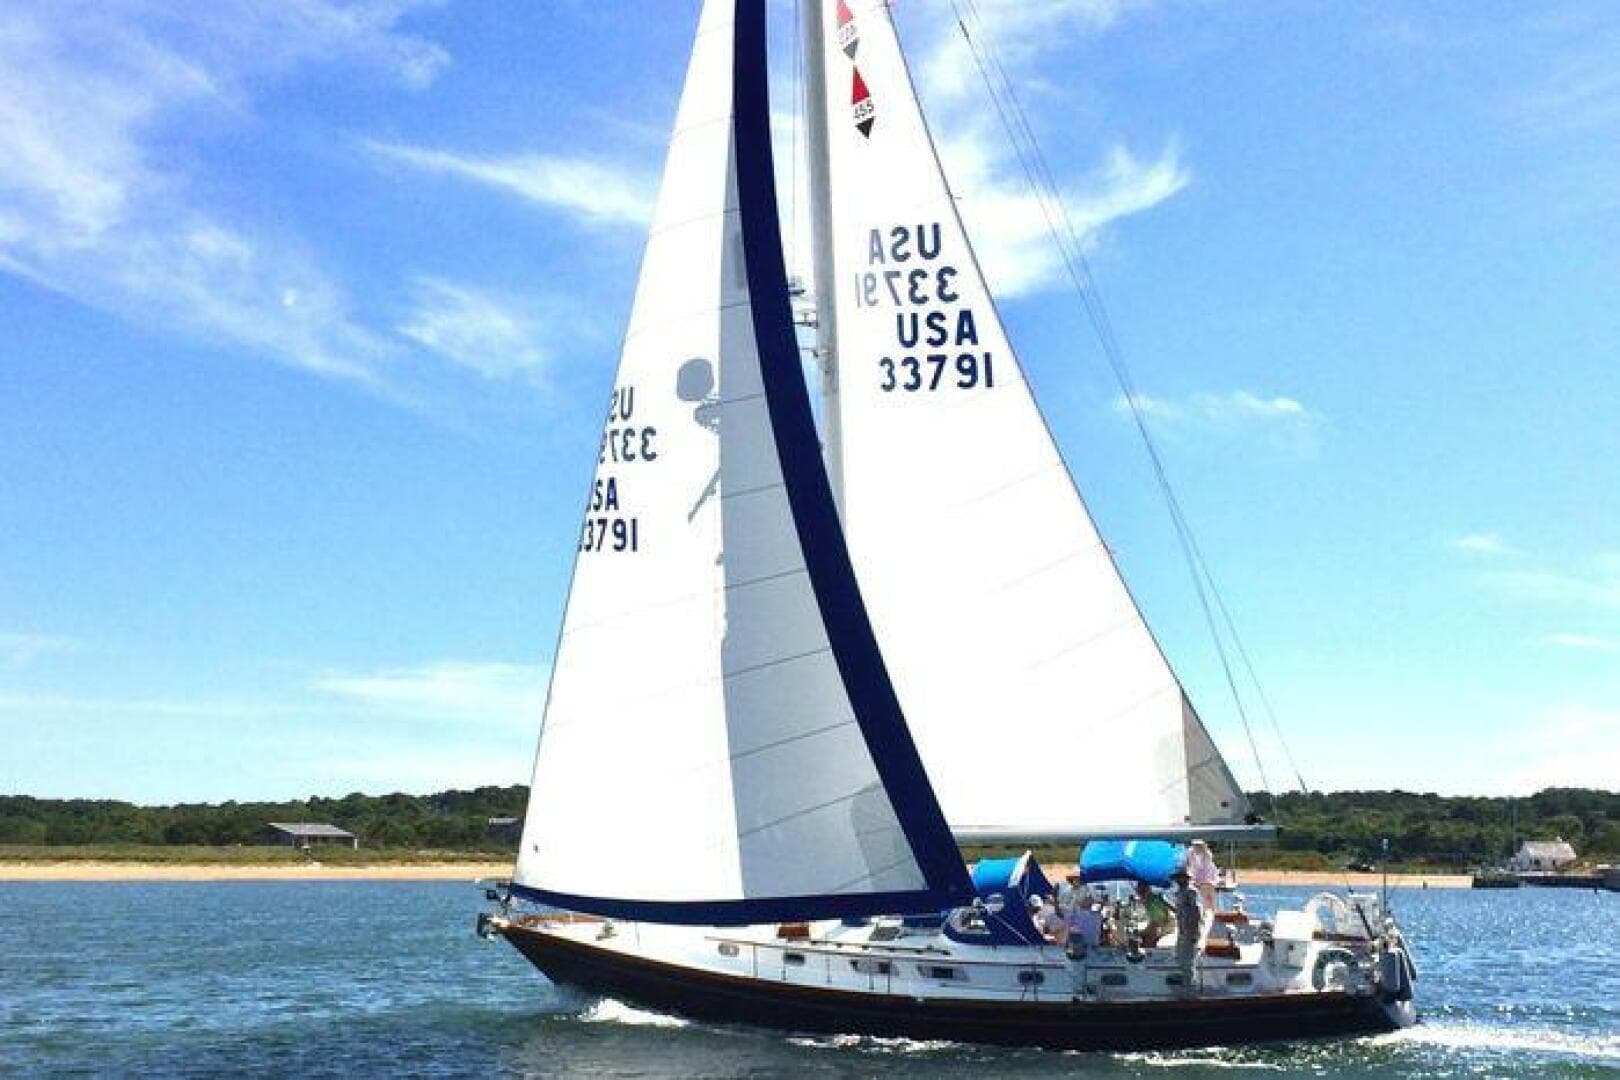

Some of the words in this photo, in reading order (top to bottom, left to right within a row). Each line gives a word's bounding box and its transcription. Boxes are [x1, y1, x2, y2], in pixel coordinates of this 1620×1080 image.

[896, 309, 978, 348] USA
[879, 352, 994, 392] 33791
[587, 477, 619, 511] SA
[578, 518, 638, 552] 3791
